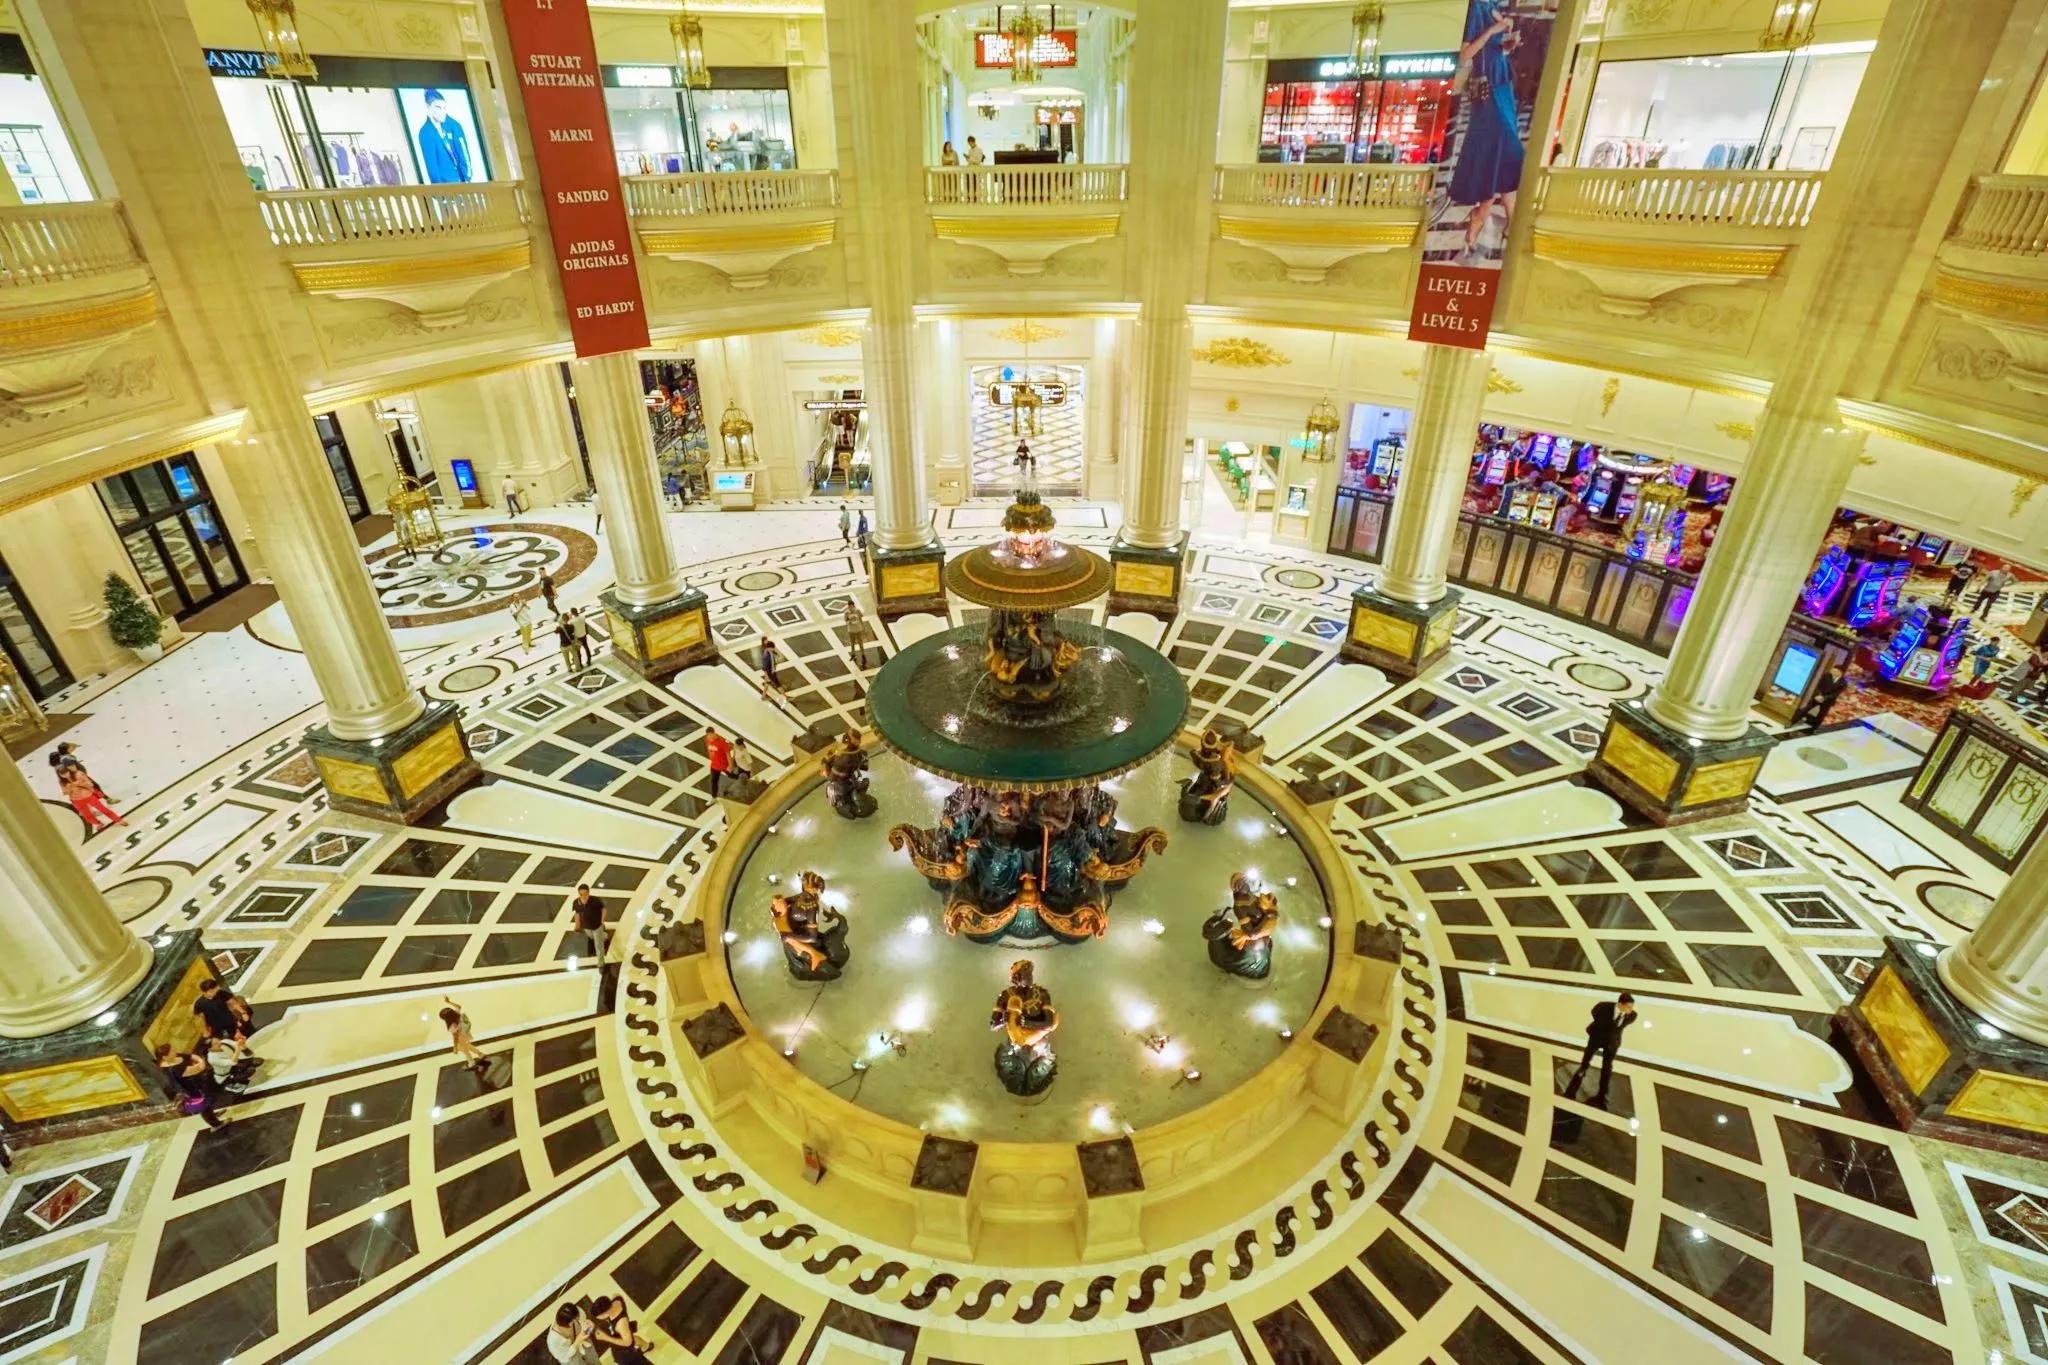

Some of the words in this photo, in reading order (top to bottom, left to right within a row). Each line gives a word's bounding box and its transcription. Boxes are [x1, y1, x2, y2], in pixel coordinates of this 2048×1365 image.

[530, 54, 582, 68] STUART
[522, 72, 595, 87] WEITZMAN
[549, 128, 594, 142] MARNI
[557, 189, 609, 204] SANDRO
[569, 239, 615, 255] ADIDAS
[563, 253, 629, 271] ORIGINALS
[1428, 277, 1473, 295] LEVEL
[1476, 281, 1487, 297] 3
[576, 306, 593, 319] ED
[595, 300, 635, 316] HARDY
[1446, 297, 1460, 312] &
[1422, 312, 1465, 331] LEVEL
[1469, 318, 1479, 333] 5
